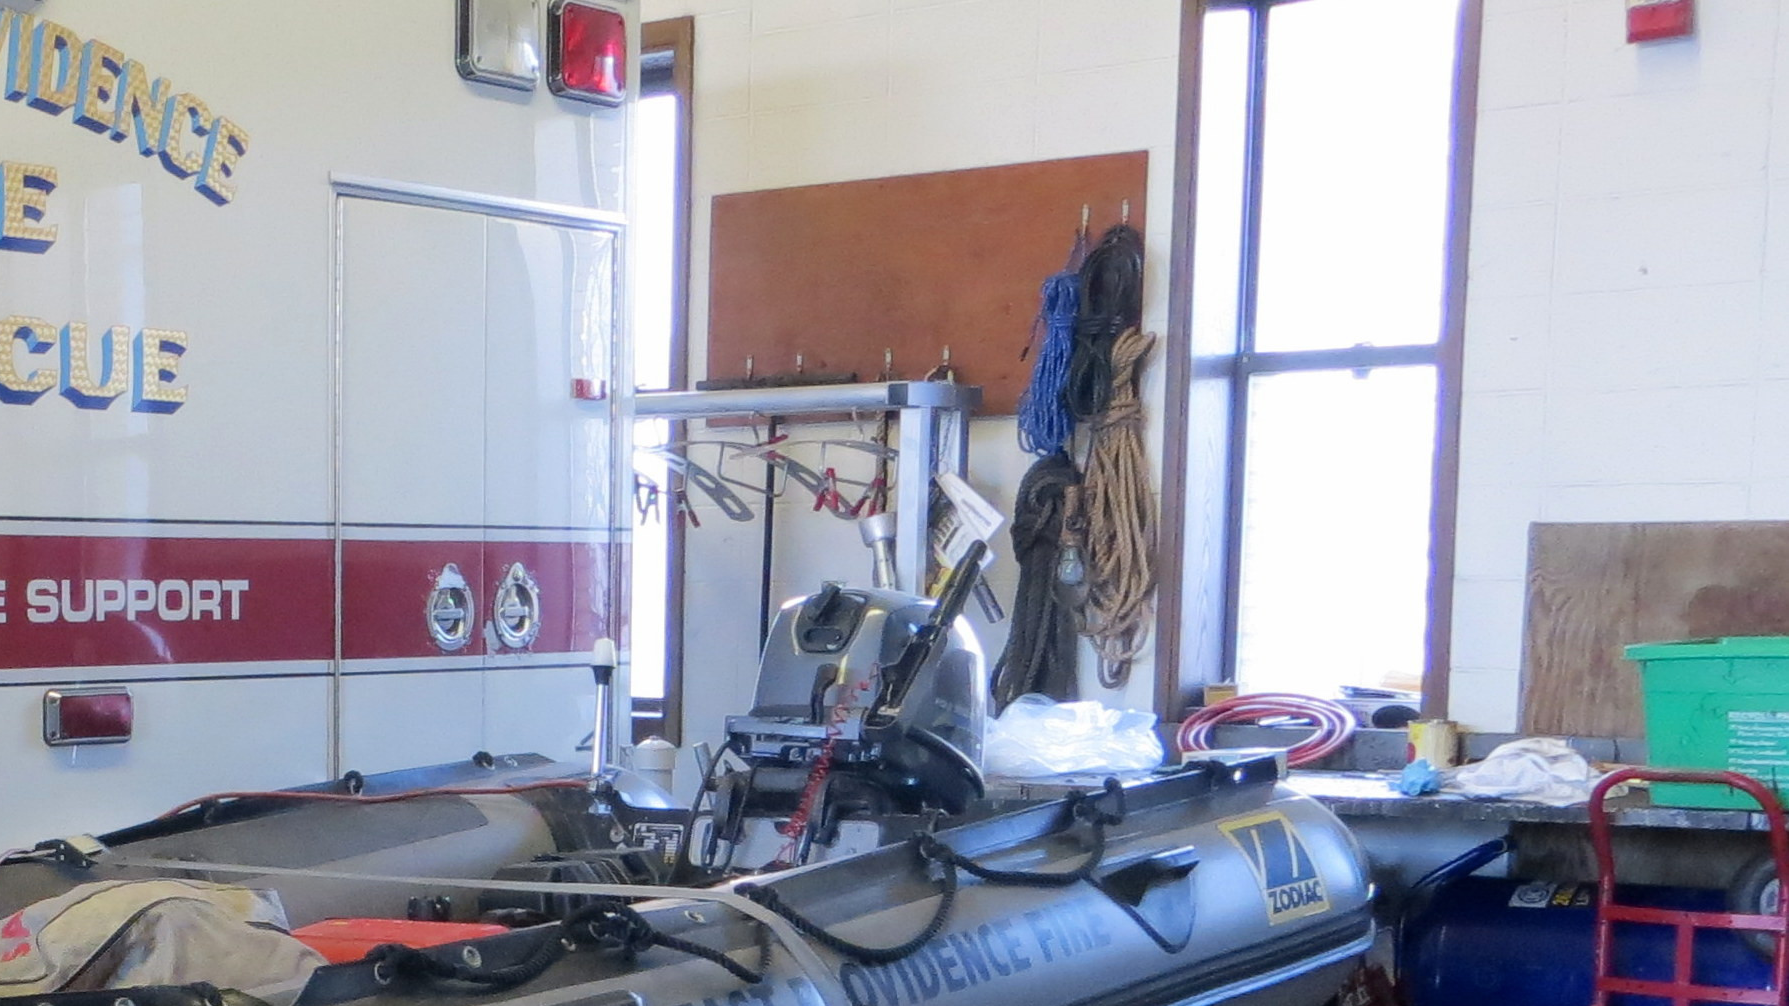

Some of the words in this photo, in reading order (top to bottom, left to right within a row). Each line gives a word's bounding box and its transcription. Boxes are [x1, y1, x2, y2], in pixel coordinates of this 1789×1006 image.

[25, 579, 249, 622] SUPPORT
[1268, 880, 1325, 915] ZODIAC
[1023, 897, 1112, 962] FIRE
